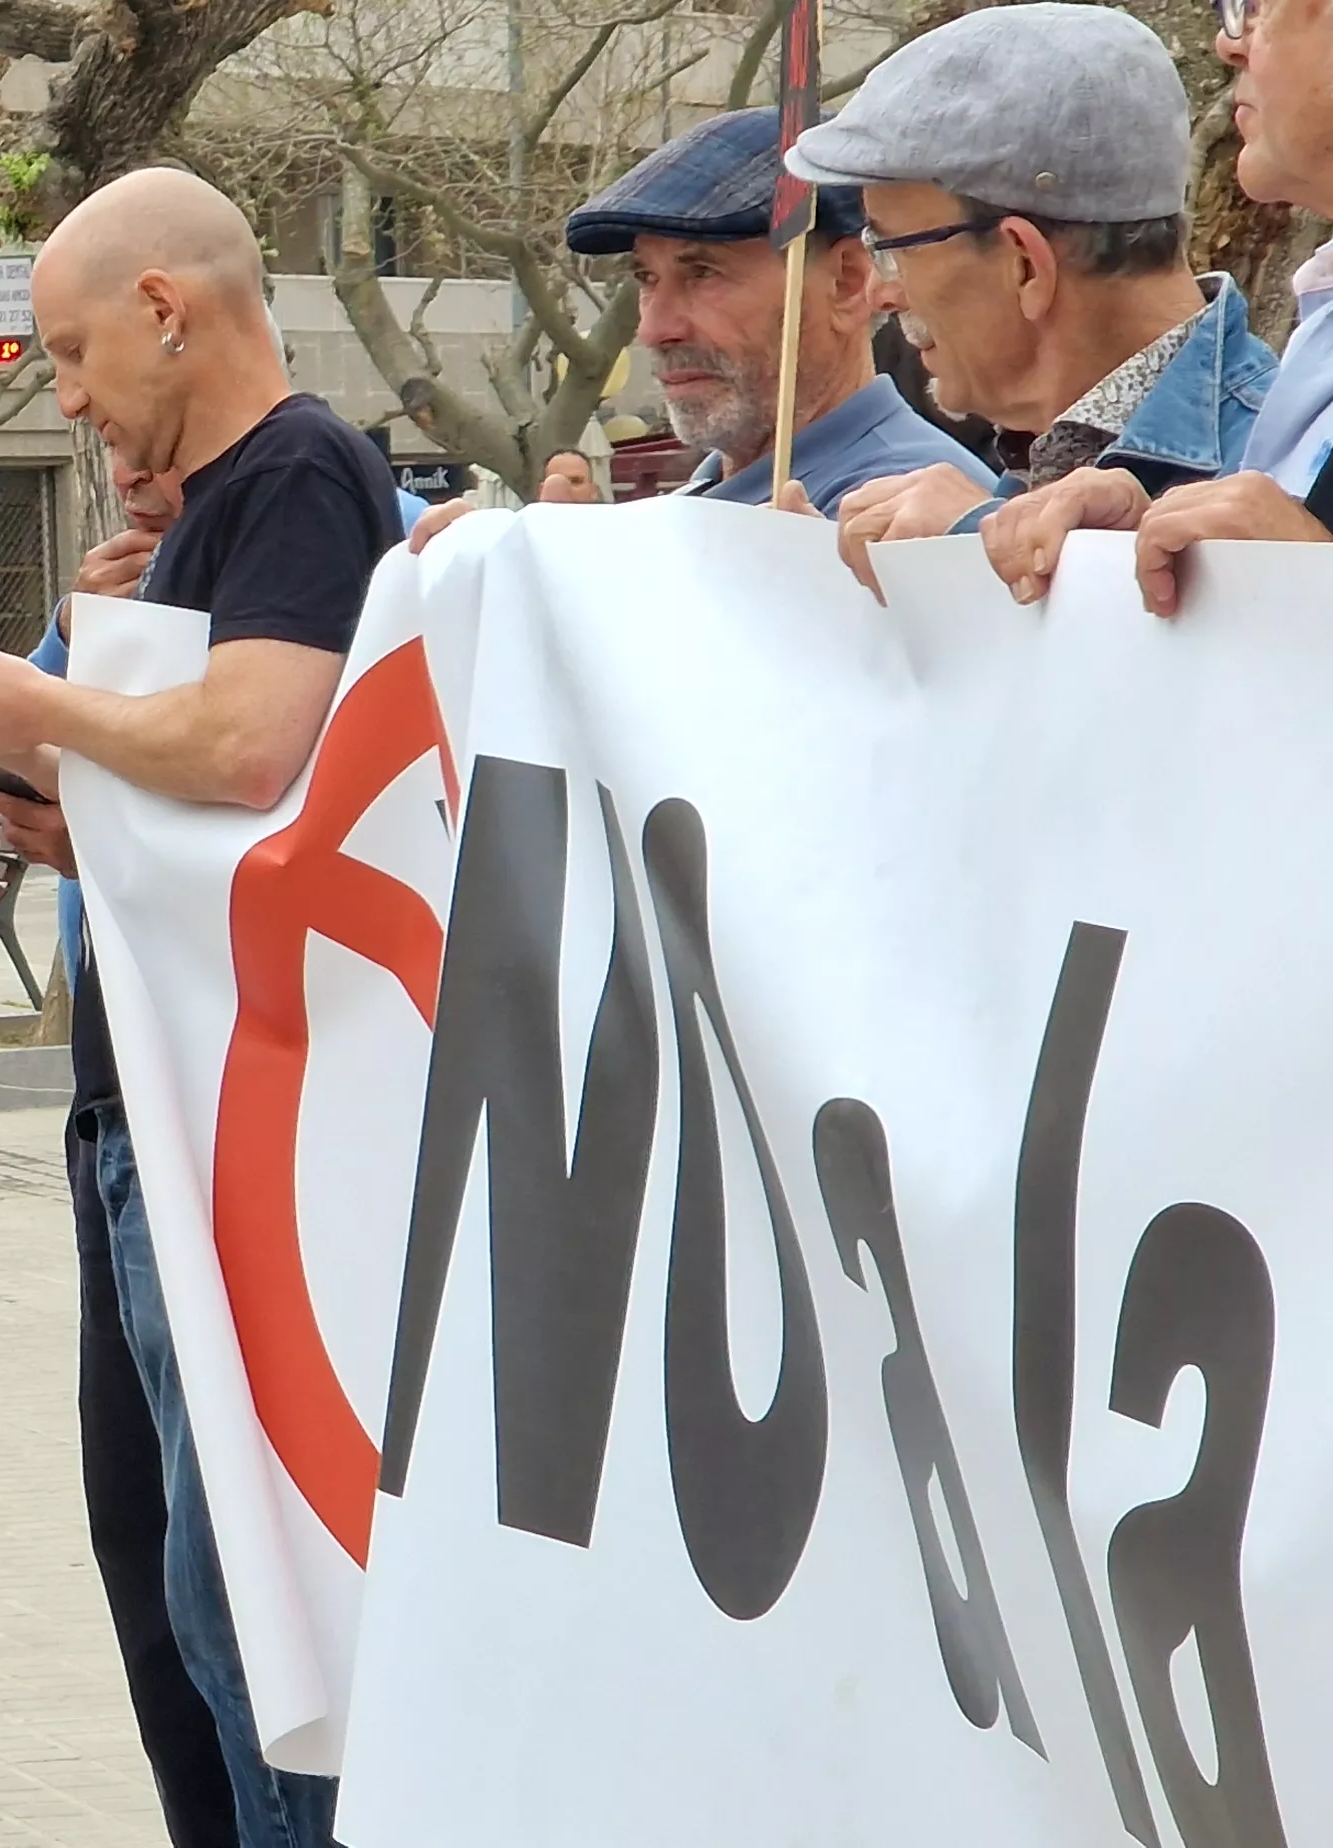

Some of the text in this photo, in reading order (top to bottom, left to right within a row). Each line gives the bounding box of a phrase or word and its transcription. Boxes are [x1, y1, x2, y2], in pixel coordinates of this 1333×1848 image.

[376, 753, 1290, 1848] NO a la
